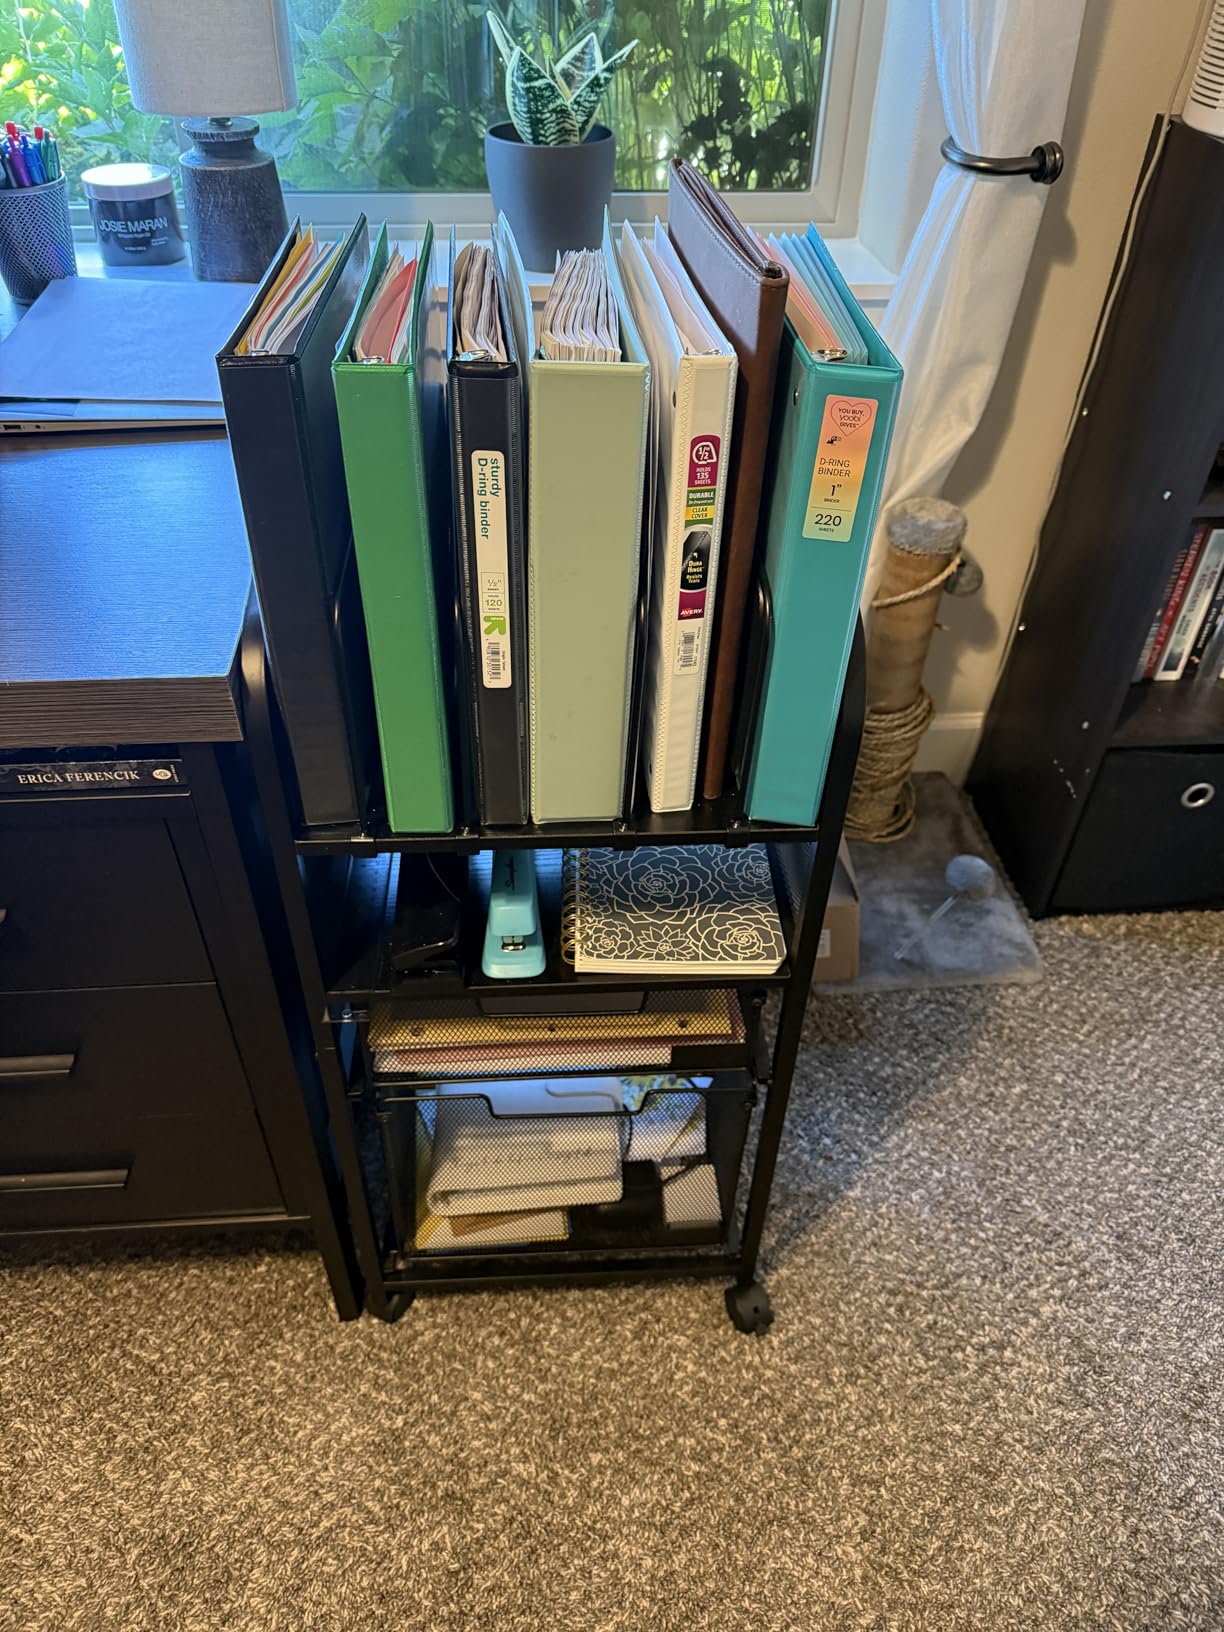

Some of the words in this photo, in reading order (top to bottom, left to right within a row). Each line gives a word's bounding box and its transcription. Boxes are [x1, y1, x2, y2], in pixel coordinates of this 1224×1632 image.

[100, 220, 127, 232] JOSIE
[128, 217, 168, 232] MARAN
[819, 457, 850, 468] D-RING
[477, 458, 488, 498] D-ring
[489, 458, 502, 498] sturdy
[696, 472, 709, 480] 135
[818, 467, 851, 478] BINDER
[689, 491, 714, 499] DURABLE
[480, 501, 491, 539] binder
[814, 513, 842, 527] 220
[486, 599, 503, 607] 120
[680, 608, 703, 616] AVERY
[17, 773, 63, 785] ERICA
[64, 770, 140, 783] FERENCIK
